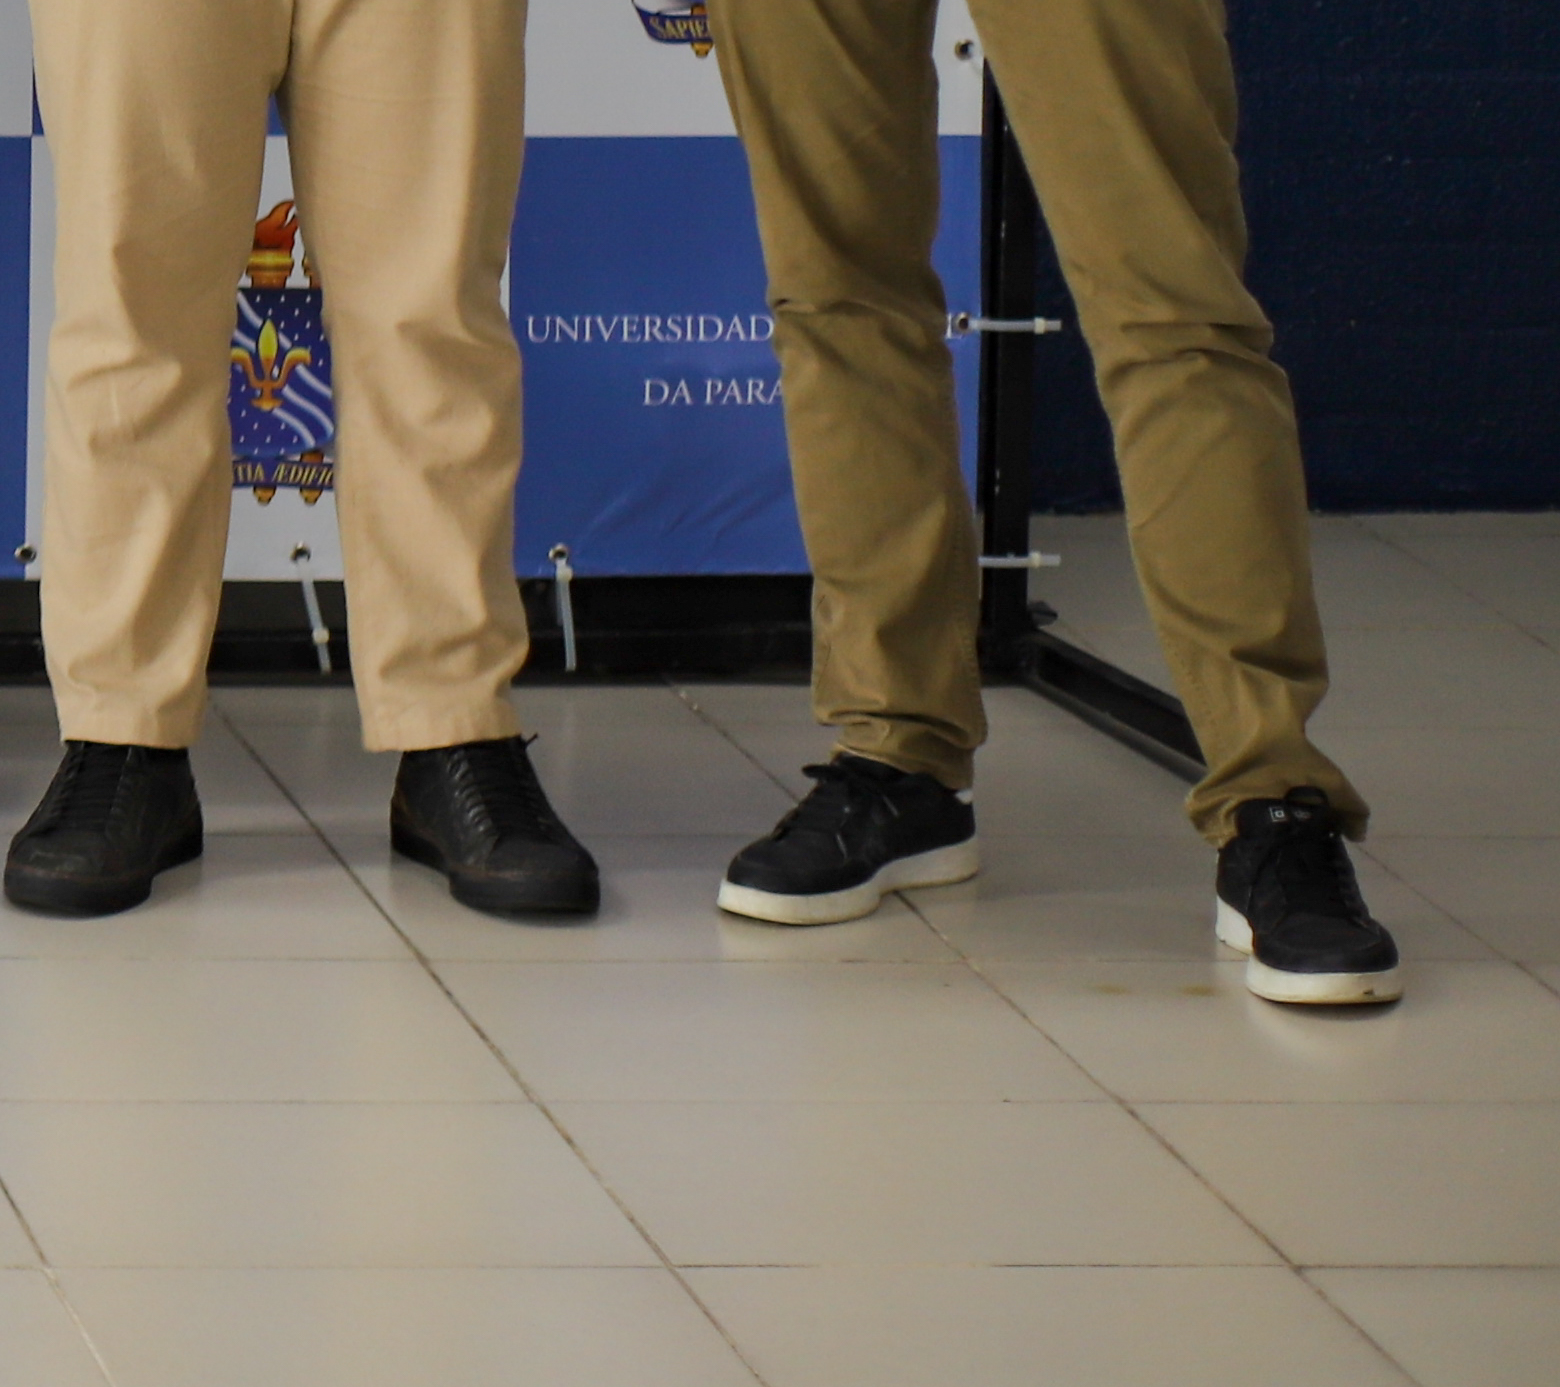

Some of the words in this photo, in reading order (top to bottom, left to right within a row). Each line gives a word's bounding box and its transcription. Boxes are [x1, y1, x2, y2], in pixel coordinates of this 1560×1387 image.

[526, 314, 775, 344] UNIVERSIDAD
[642, 377, 694, 406] DA
[703, 377, 784, 406] PARA
